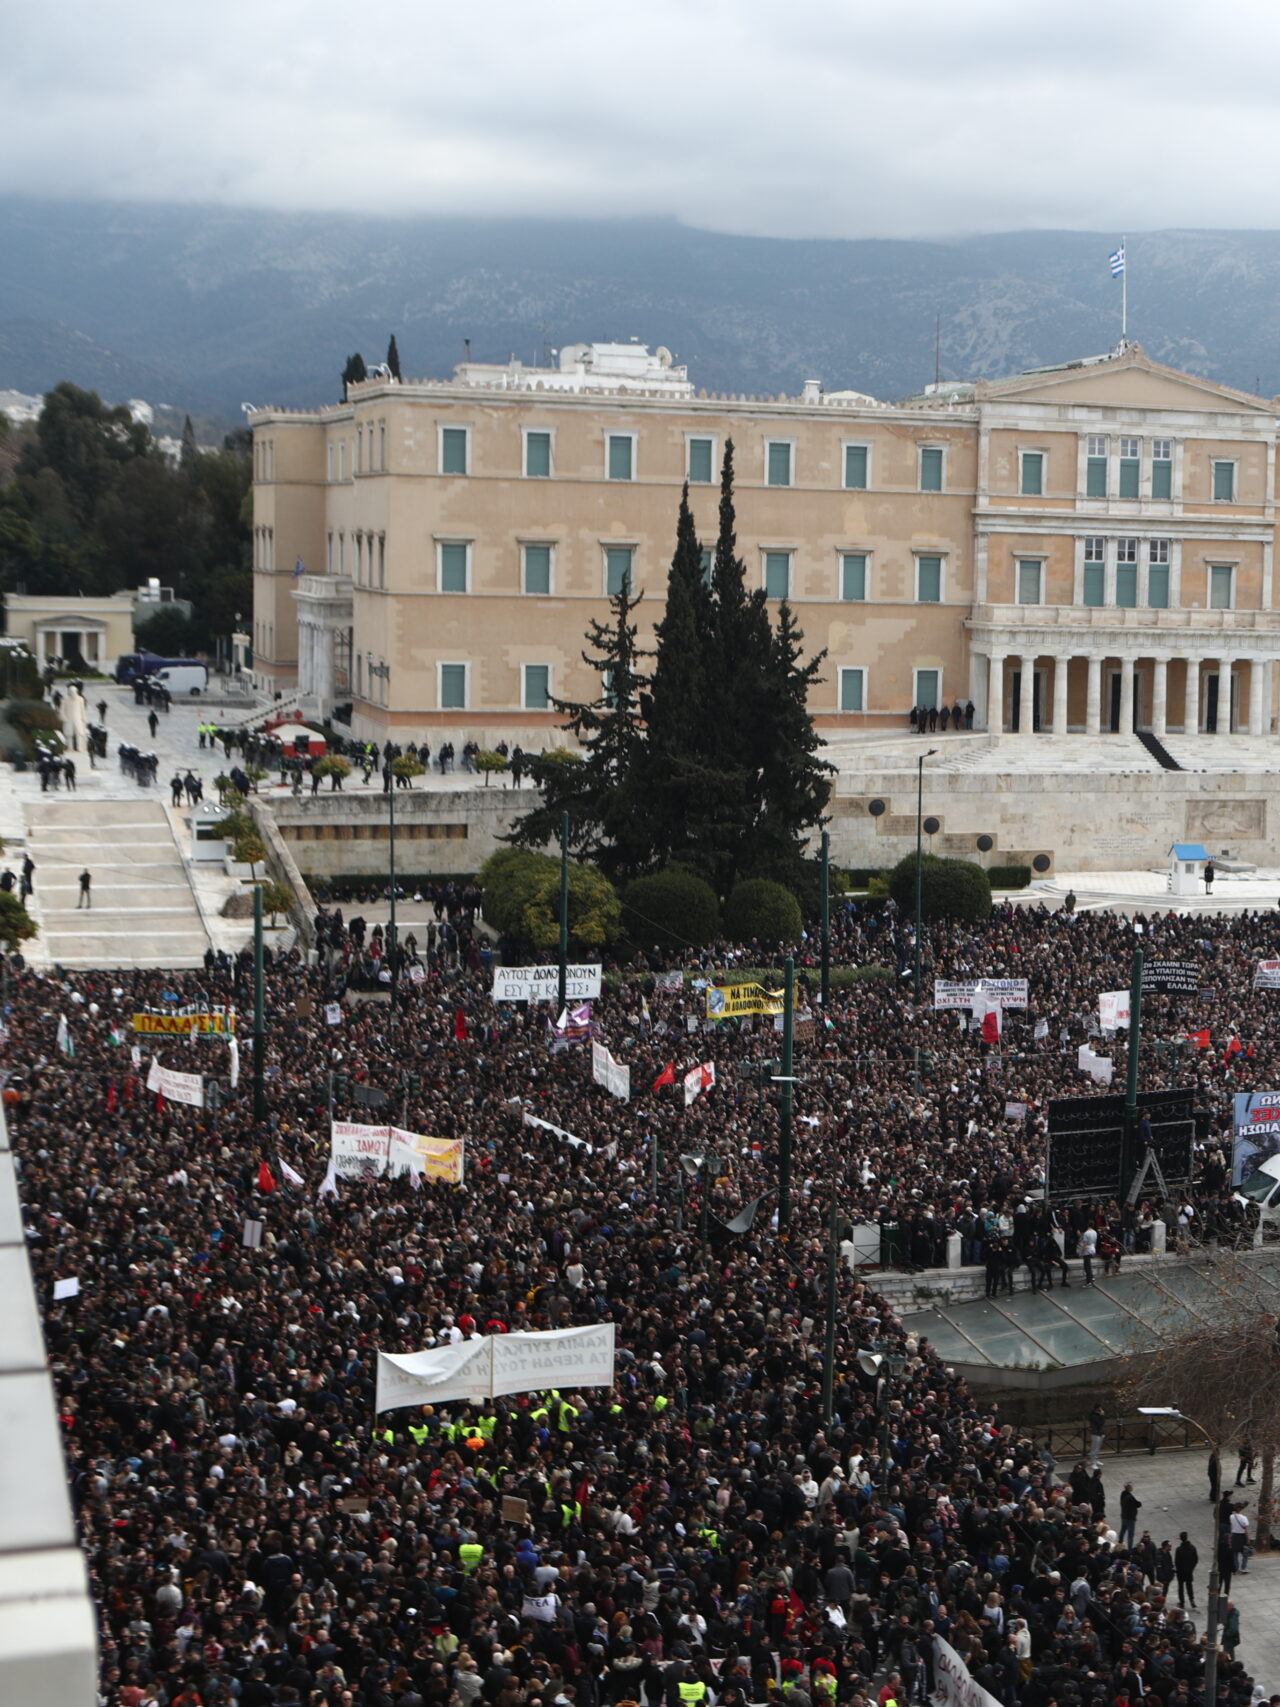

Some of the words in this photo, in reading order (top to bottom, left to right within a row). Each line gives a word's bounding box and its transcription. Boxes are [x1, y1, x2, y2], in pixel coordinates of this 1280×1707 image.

[534, 967, 596, 980] ΔΟΛΟΟΝΟΥΝ
[504, 984, 522, 996] ΕΣΥ
[545, 983, 589, 995] ΚΑΕΙΣ;
[731, 988, 741, 999] ΝΑ
